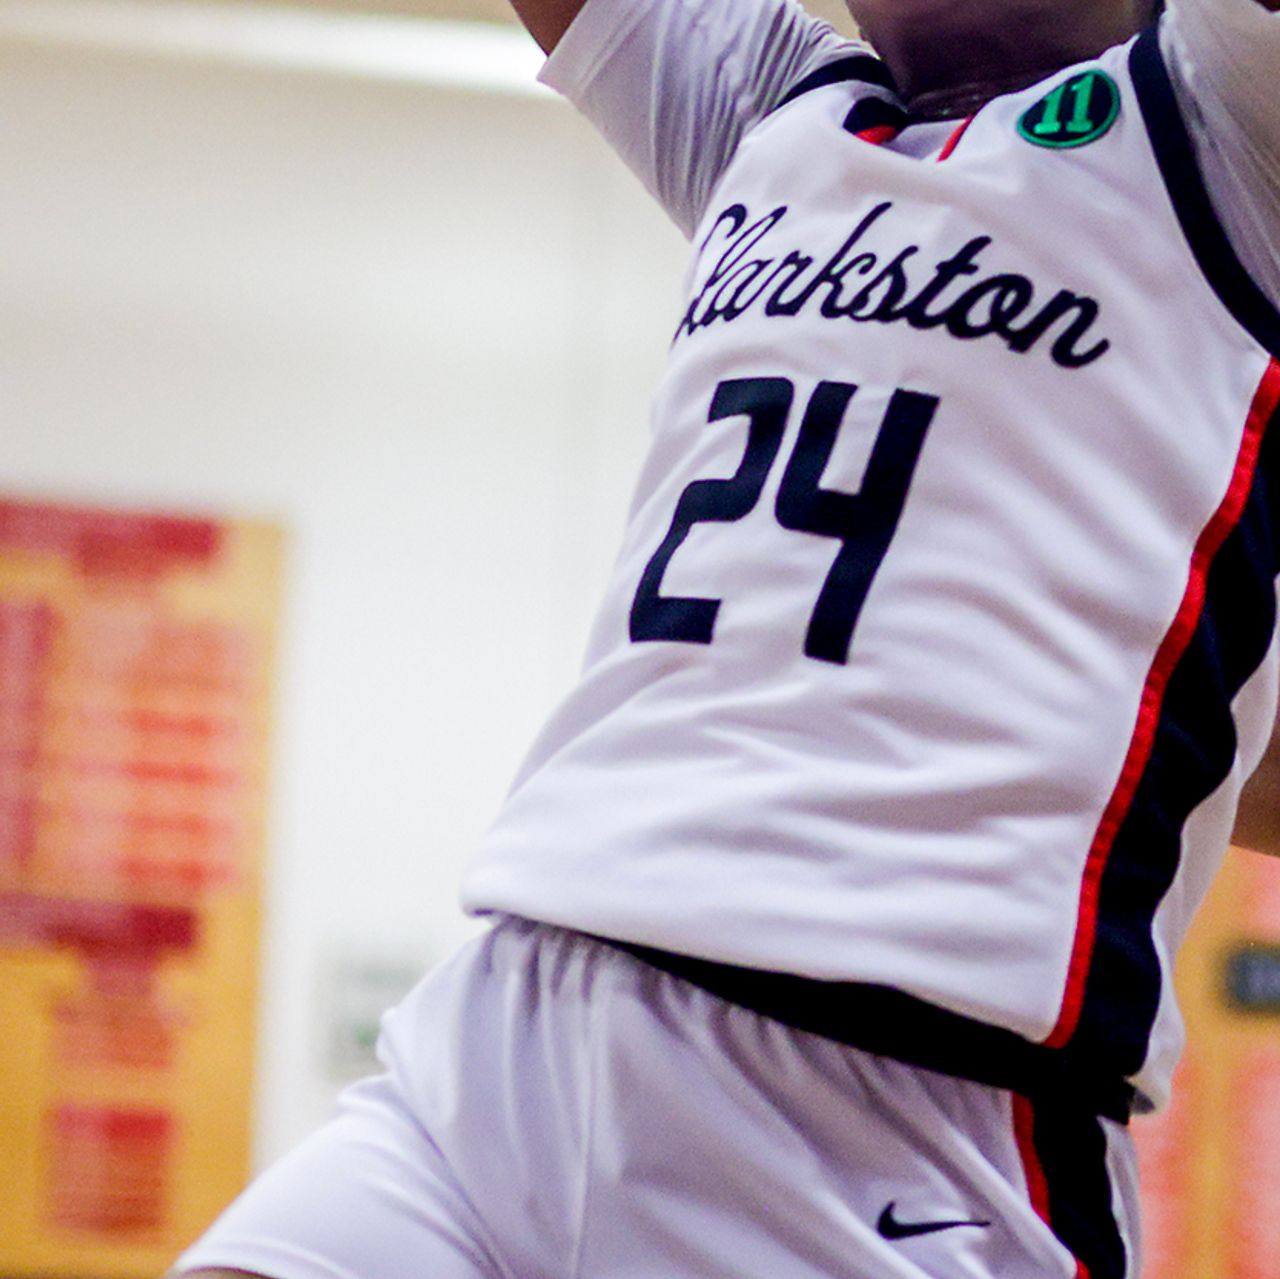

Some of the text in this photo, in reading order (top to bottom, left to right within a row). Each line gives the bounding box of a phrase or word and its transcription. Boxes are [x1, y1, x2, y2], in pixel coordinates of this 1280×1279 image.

[1033, 70, 1095, 134] 11
[672, 200, 1110, 369] Clarkston
[629, 376, 941, 665] 24
